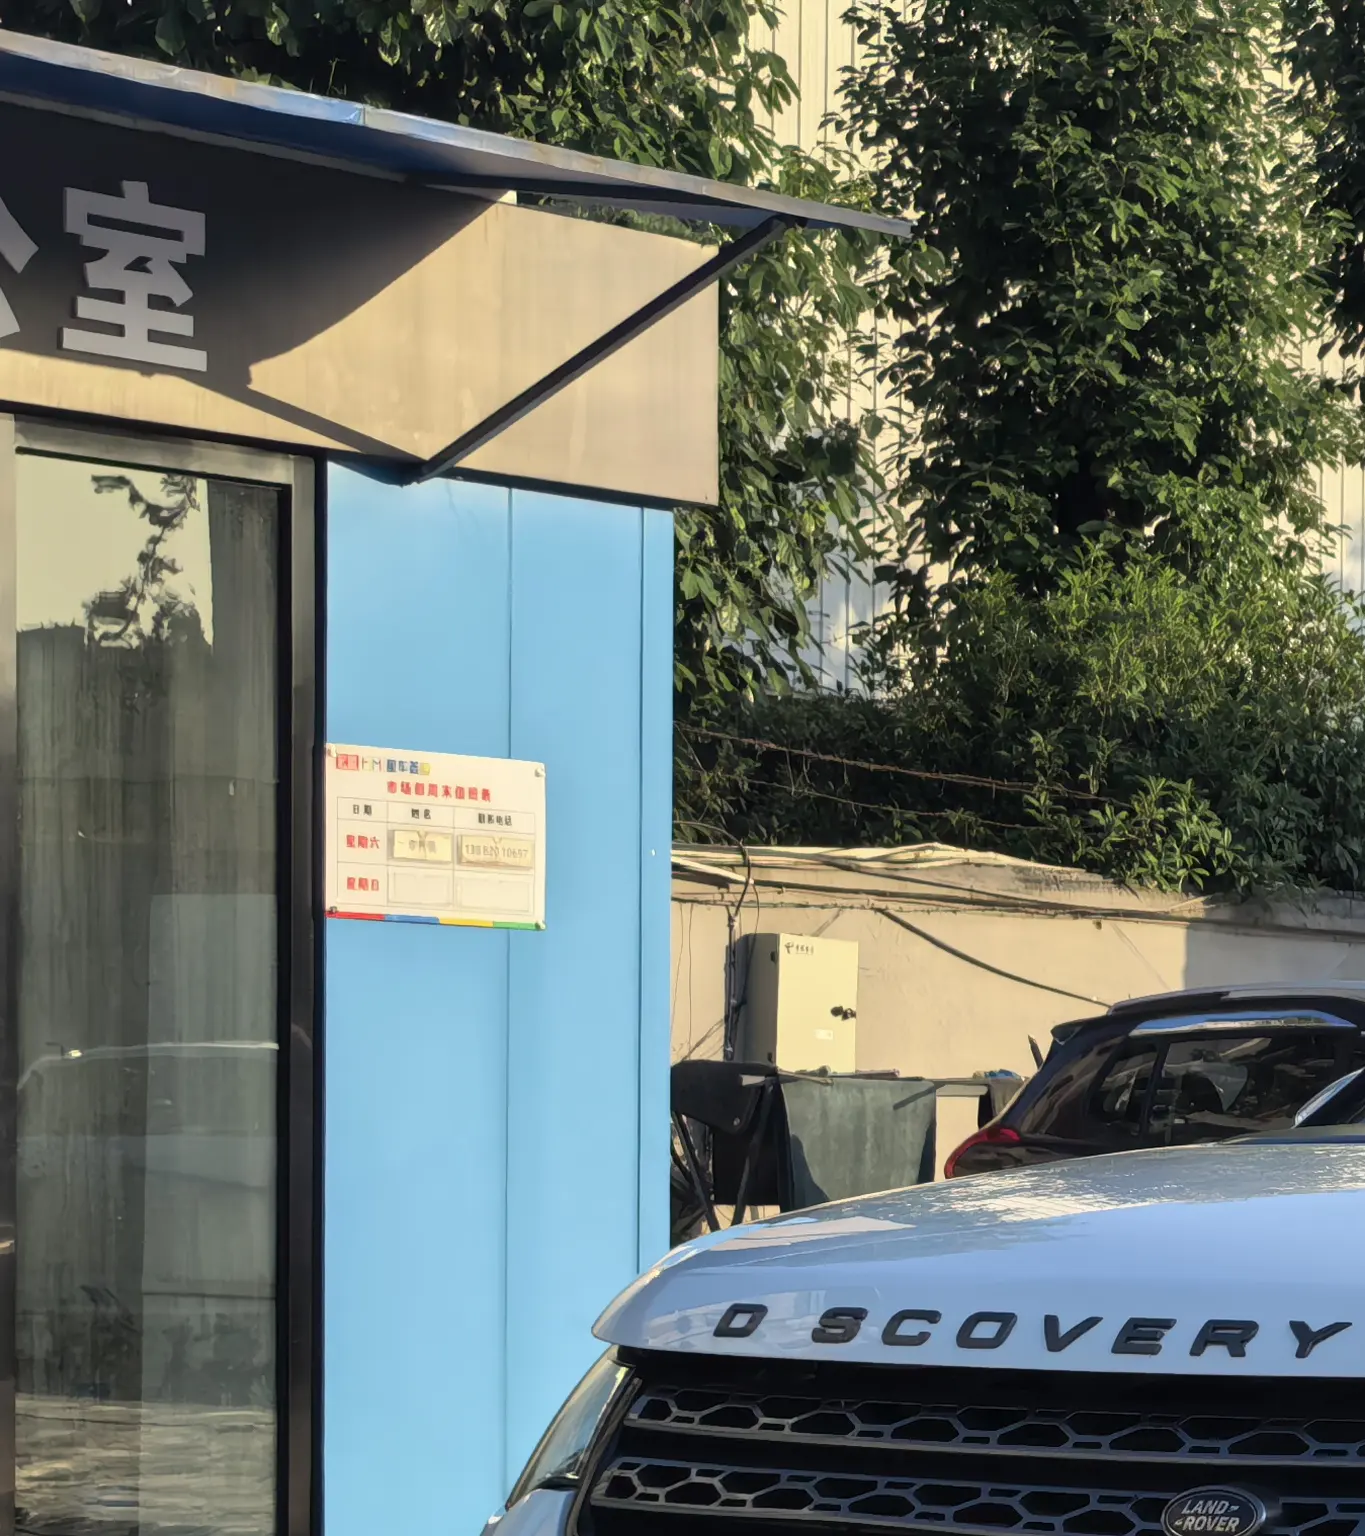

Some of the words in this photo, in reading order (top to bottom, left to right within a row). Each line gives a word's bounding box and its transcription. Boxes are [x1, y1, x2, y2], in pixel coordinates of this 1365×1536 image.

[346, 835, 380, 849] 星期六
[713, 1303, 1353, 1359] DSCOVERY
[1181, 1500, 1229, 1515] LAND
[1182, 1516, 1240, 1532] ROVER
